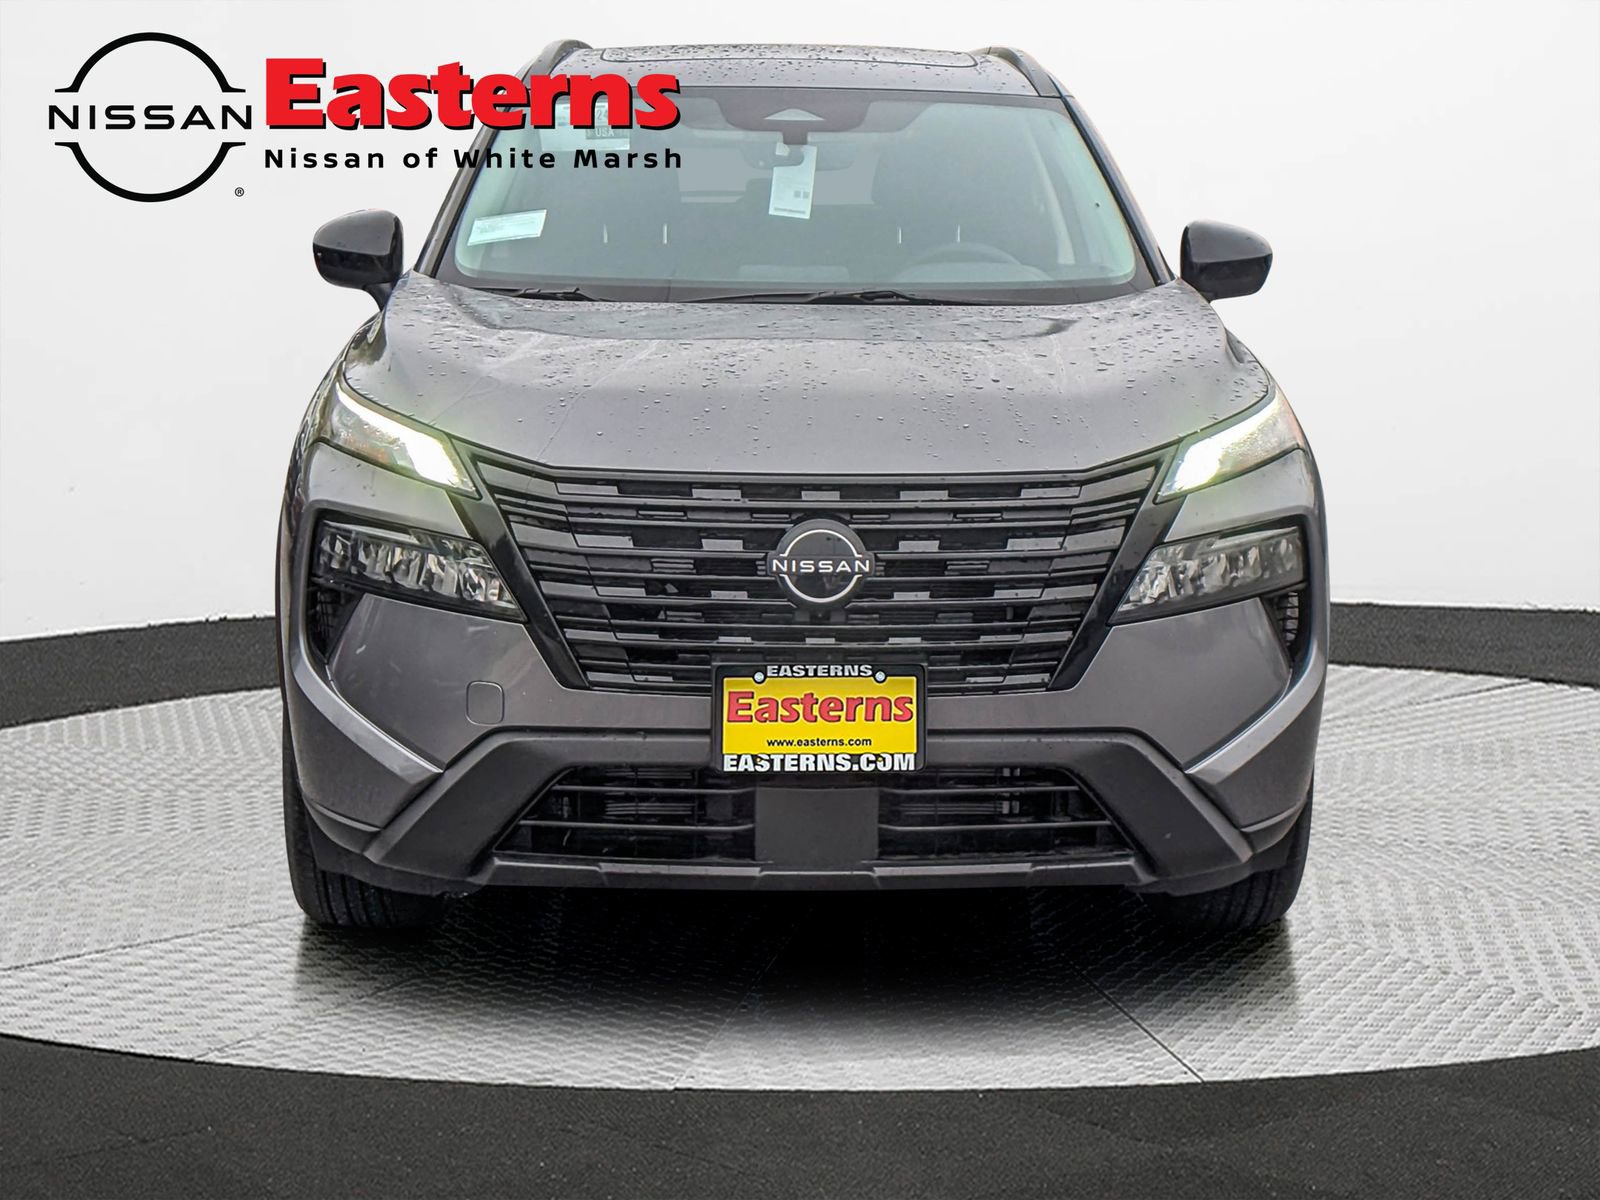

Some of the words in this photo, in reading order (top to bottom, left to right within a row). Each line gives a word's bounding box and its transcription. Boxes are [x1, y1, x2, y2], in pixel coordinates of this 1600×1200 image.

[772, 559, 870, 573] NISSAN
[766, 665, 873, 677] EASTERNS
[727, 691, 914, 723] Easterns
[766, 736, 872, 747] www.easterns.com
[723, 753, 915, 772] EASTERNS.COM
